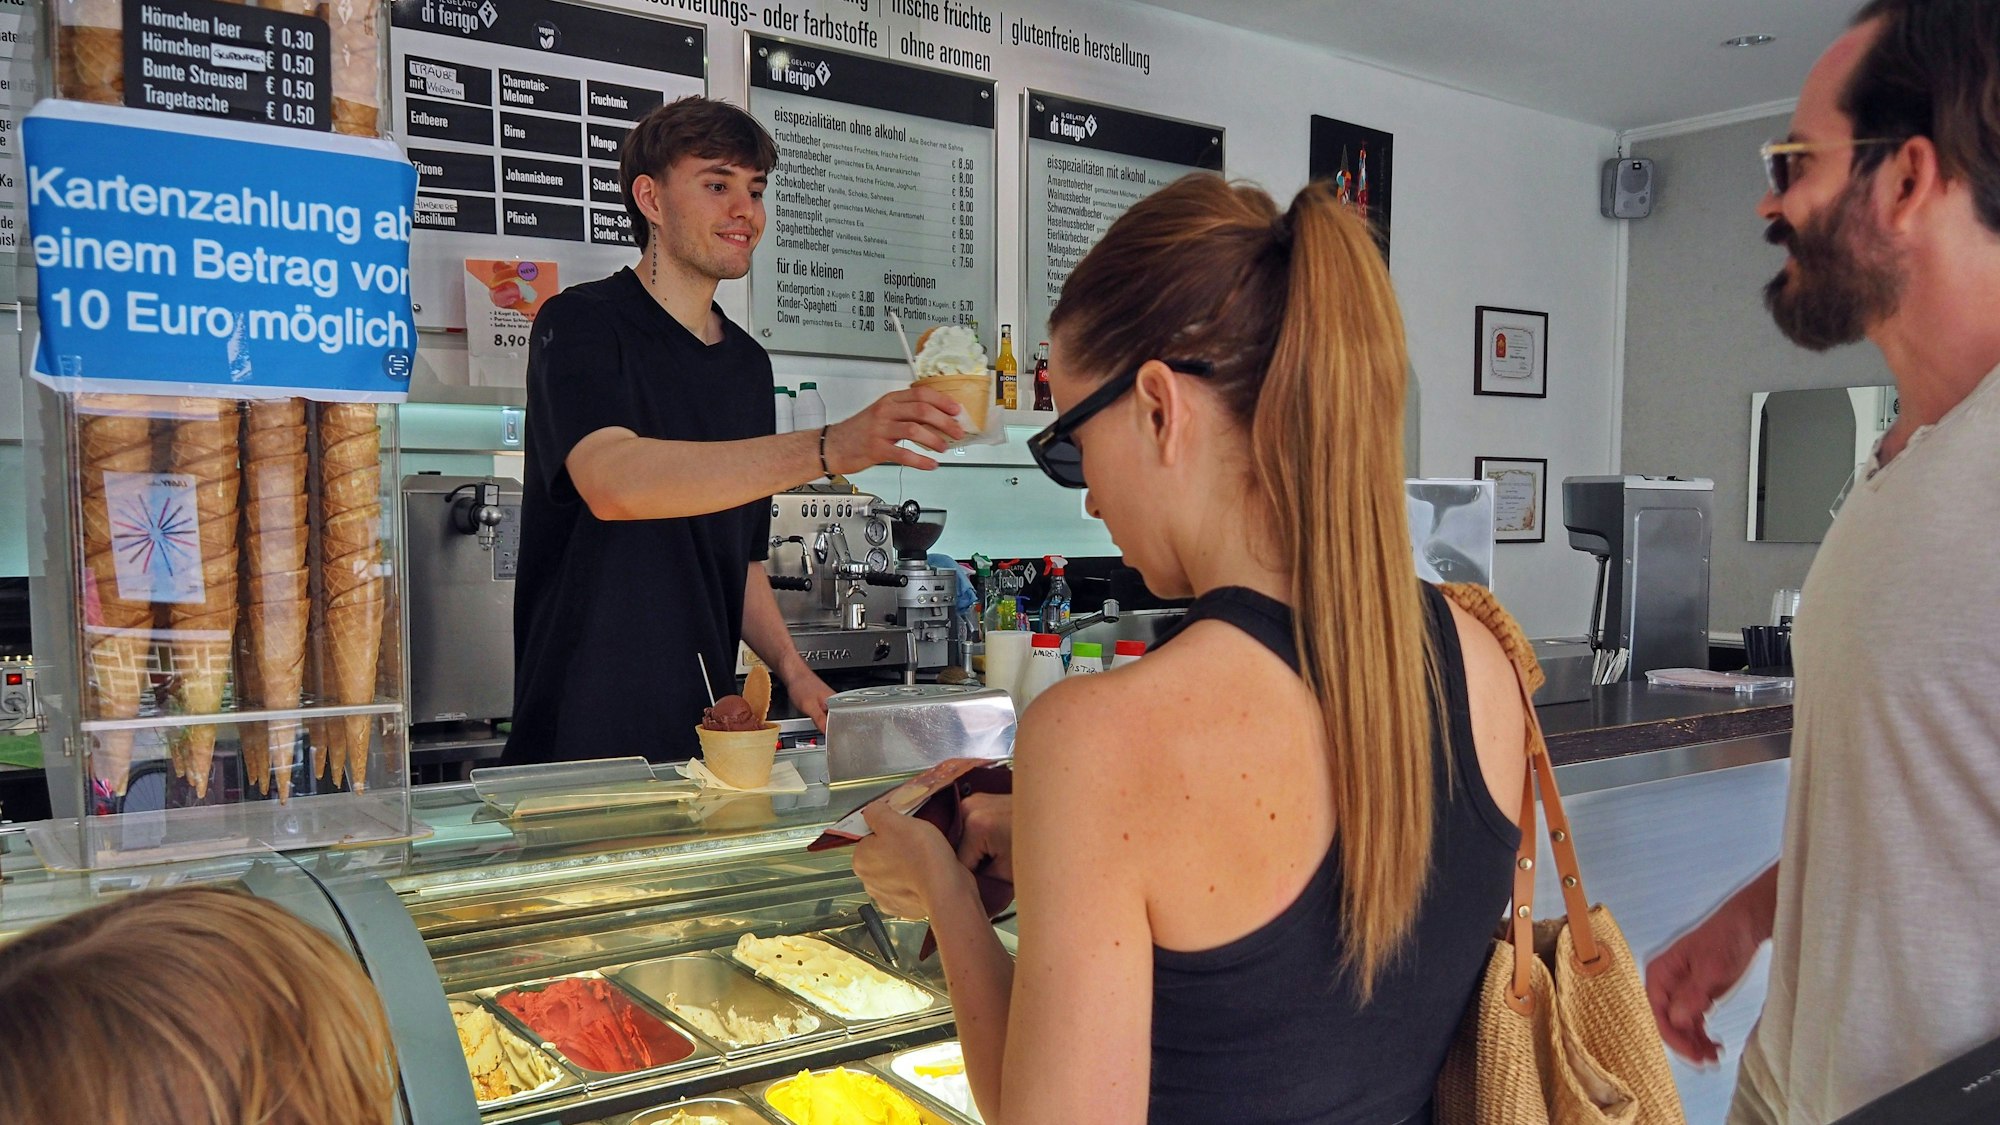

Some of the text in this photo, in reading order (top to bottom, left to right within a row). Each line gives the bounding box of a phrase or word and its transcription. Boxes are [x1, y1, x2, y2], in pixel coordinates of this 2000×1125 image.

[141, 4, 209, 34] Hörnchen
[213, 16, 242, 39] leer
[264, 25, 275, 45] €
[422, 0, 479, 34] di ferigo
[763, 3, 799, 32] oder
[803, 9, 878, 49] farbstoffe
[944, 0, 991, 34] früchte
[538, 26, 554, 36] vegan
[142, 31, 210, 60] Hörnchen
[901, 31, 990, 73] ohne aromen
[1012, 17, 1150, 76] glutenfreie herstellung
[265, 51, 275, 70] €
[412, 62, 455, 81] TRAUBE
[791, 59, 815, 69] GELATO
[142, 57, 186, 82] Bunte
[189, 64, 248, 91] Streusel
[265, 76, 276, 95] €
[410, 77, 424, 90] mit
[502, 73, 549, 92] Charentais-
[785, 65, 816, 91] ferigo
[143, 83, 230, 114] Tragetasche
[265, 101, 276, 120] €
[503, 88, 534, 105] Melone
[590, 91, 628, 110] Fruchtmix
[410, 110, 448, 128] Erdbeere
[774, 106, 846, 132] eisspezialitäten
[849, 119, 872, 136] ohne
[874, 124, 906, 142] alkohol
[1050, 114, 1086, 142] di ferigo
[1066, 113, 1085, 122] GELATO
[503, 124, 526, 139] Birne
[590, 135, 617, 152] Mango
[775, 129, 821, 147] Fruchtbecher
[952, 160, 956, 168] €
[958, 158, 974, 170] 8.50
[776, 143, 832, 163] Amarenabecher
[952, 174, 956, 183] €
[959, 172, 974, 185] 8.00
[1047, 154, 1146, 184] eisspezialitäten mit alkohol
[506, 168, 563, 186] Johannisbeere
[776, 157, 826, 177] Joghurtbecher
[952, 188, 956, 197] €
[959, 186, 974, 199] 8.50
[1047, 174, 1093, 191] Amarettobecher
[775, 174, 825, 193] Schokobecher
[952, 202, 956, 211] €
[1047, 187, 1091, 204] Walnussbecher
[29, 165, 411, 245] Kartenzahlung ab
[776, 190, 831, 208] Kartoffelbecher
[952, 216, 956, 225] €
[1047, 201, 1103, 219] Schwarzwaldbecher
[414, 211, 456, 226] Basilikum
[507, 210, 537, 226] Pfirsich
[776, 205, 823, 223] Bananensplit
[952, 230, 956, 239] €
[959, 228, 974, 240] 8.50
[1047, 215, 1095, 232] Haselnussbecher
[594, 227, 620, 241] Sorbet
[776, 220, 834, 238] Spaghettibecher
[952, 245, 956, 253] €
[960, 243, 974, 255] 7.00
[776, 235, 829, 253] Caramelbecher
[952, 259, 956, 267] €
[960, 256, 974, 268] 7.50
[33, 228, 177, 276] einem
[193, 239, 338, 298] Betrag
[776, 257, 844, 280] für die kleinen
[884, 269, 936, 289] eisportionen
[777, 280, 825, 297] Kinderportion
[851, 291, 857, 300] €
[859, 290, 875, 303] 3.80
[884, 291, 904, 304] Kleine
[905, 293, 928, 306] Portion
[952, 301, 956, 310] €
[960, 300, 974, 312] 5.70
[777, 295, 875, 317] Kinder-Spaghetti € 6.00
[903, 307, 927, 321] Portion
[952, 315, 957, 323] €
[52, 288, 409, 355] 10 Euro möglich
[777, 310, 800, 324] Clown
[852, 320, 857, 329] €
[859, 319, 875, 332] 7.40
[494, 334, 526, 347] 8,90
